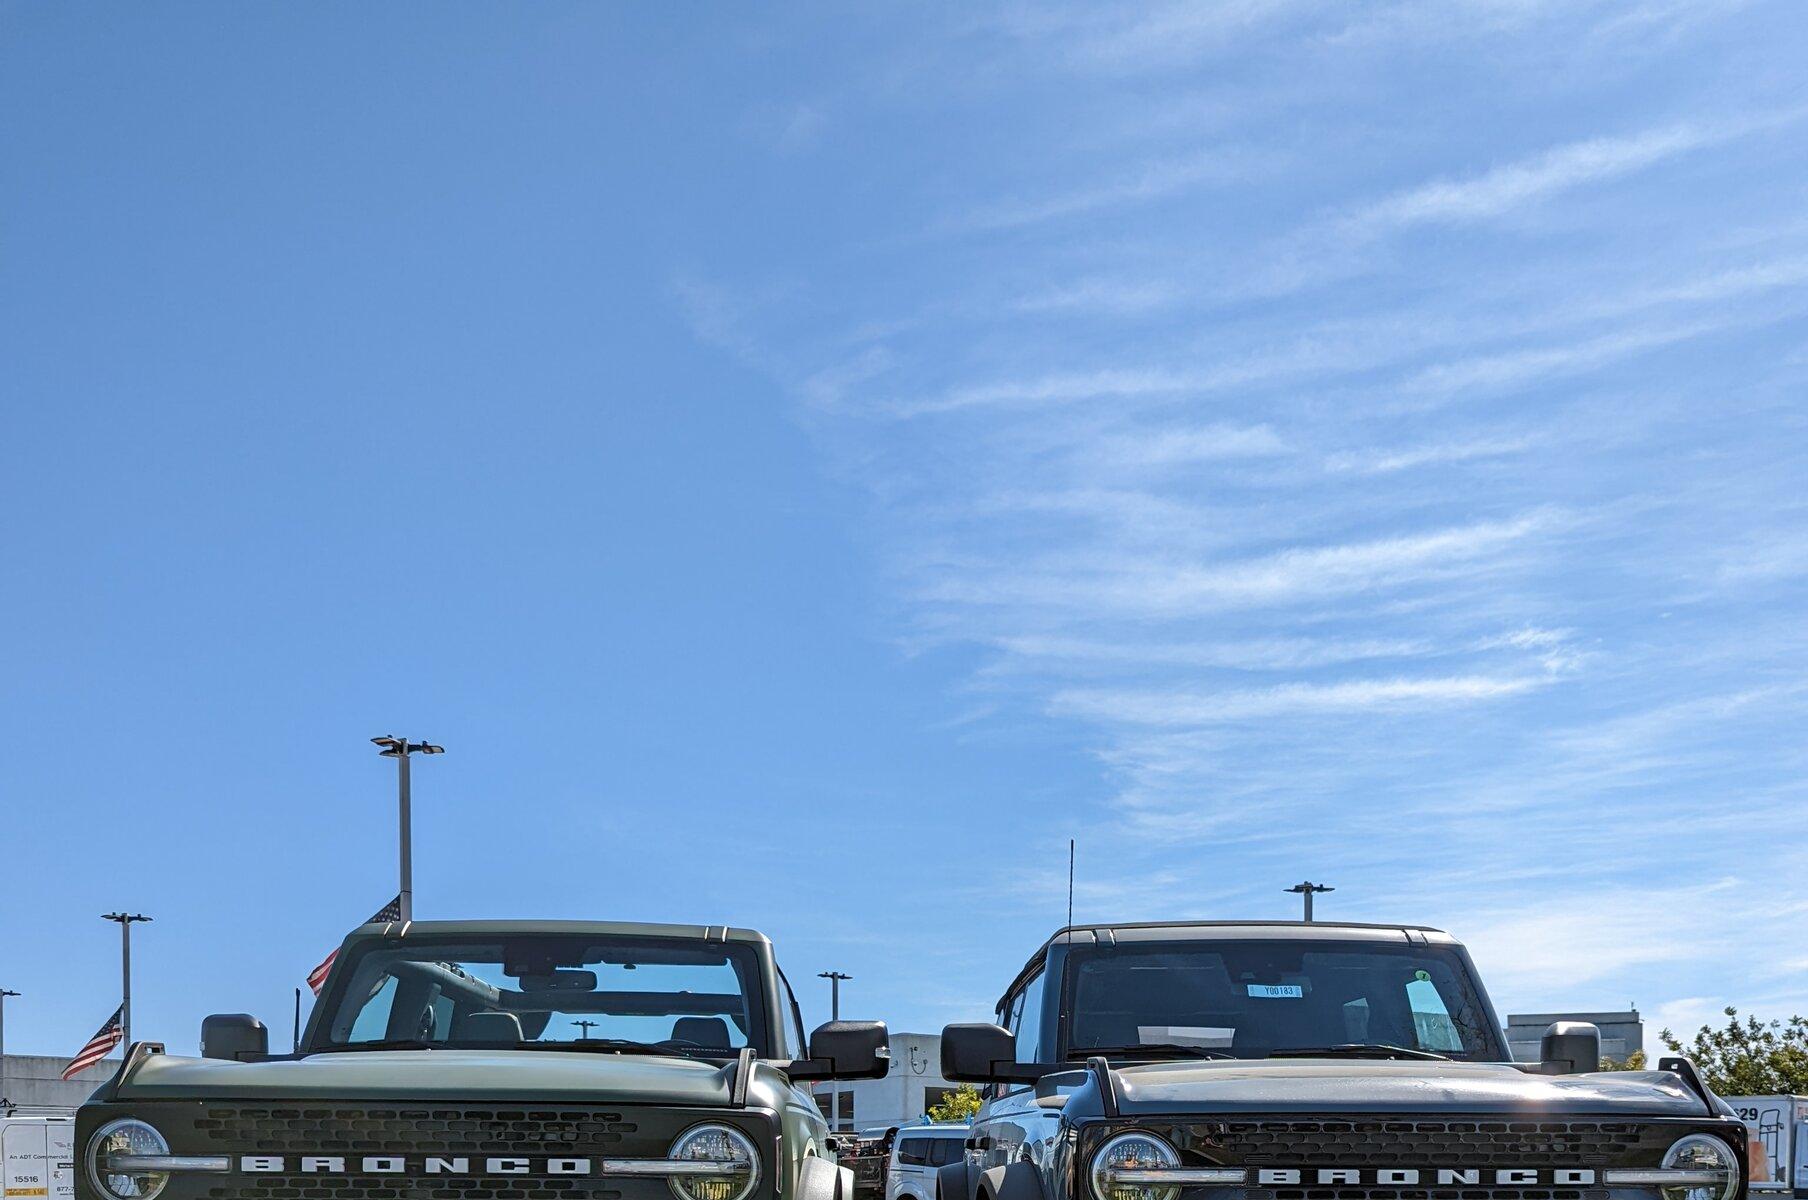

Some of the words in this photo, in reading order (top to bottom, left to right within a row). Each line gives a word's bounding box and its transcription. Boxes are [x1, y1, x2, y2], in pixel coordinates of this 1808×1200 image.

[241, 1156, 591, 1174] BRONCO
[14, 1175, 39, 1183] 15516
[1258, 1169, 1596, 1185] BRONCO
